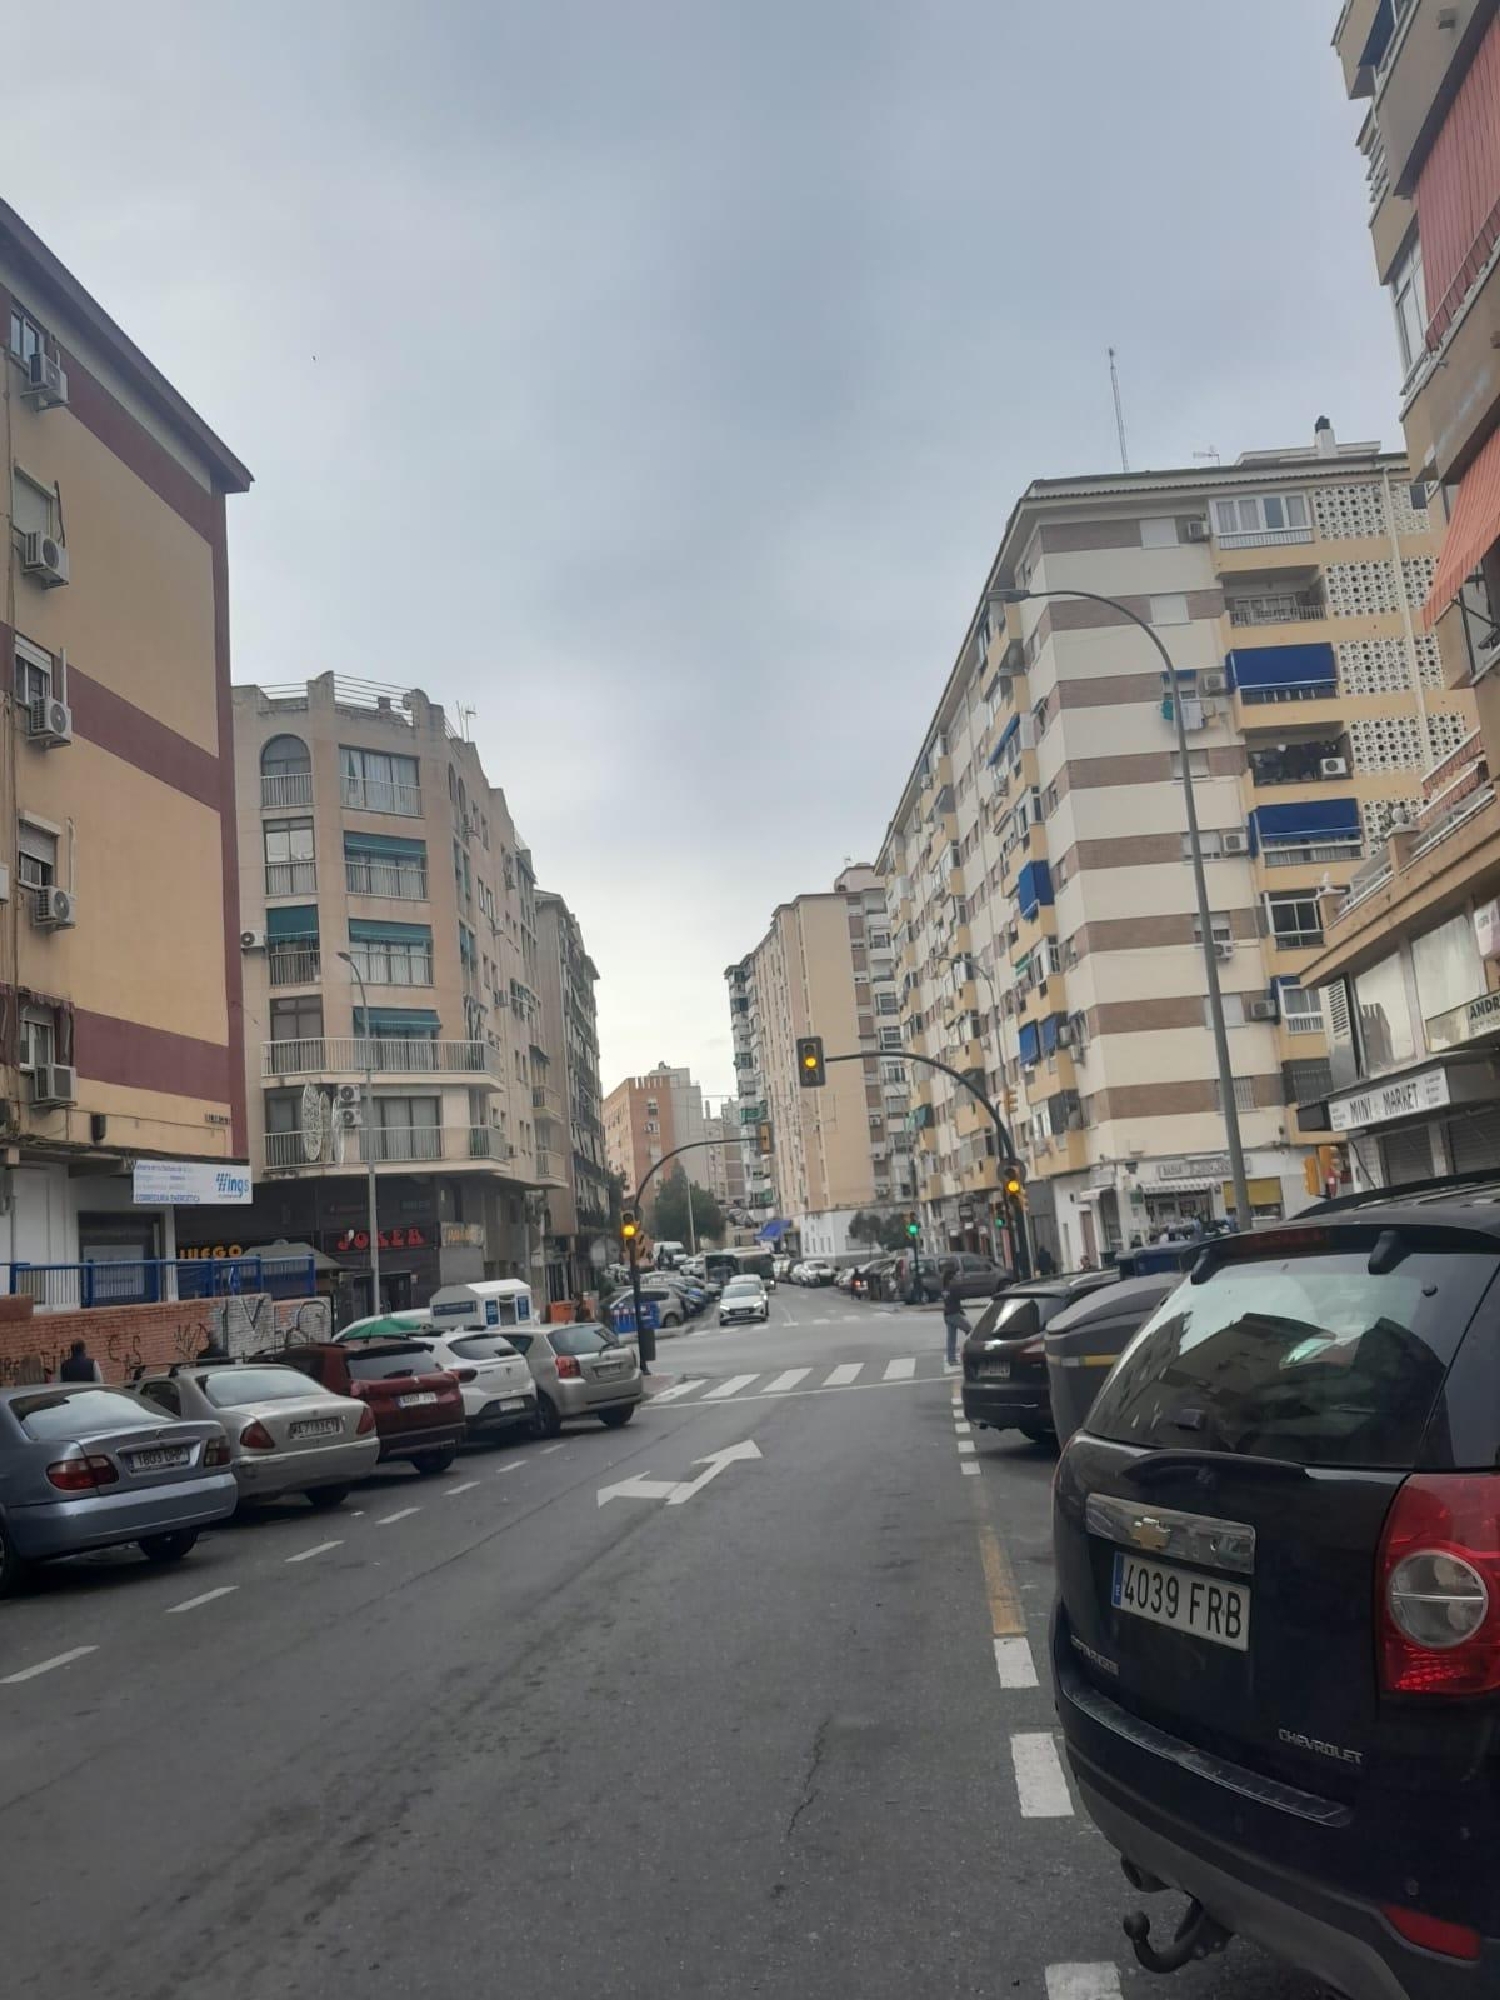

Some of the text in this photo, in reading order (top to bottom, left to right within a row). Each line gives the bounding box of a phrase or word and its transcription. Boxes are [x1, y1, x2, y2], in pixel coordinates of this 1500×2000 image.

[1469, 994, 1500, 1020] ANDR
[1383, 1082, 1420, 1116] MARKET
[1124, 1564, 1241, 1639] 4039 FRB
[1279, 1728, 1363, 1764] CHEVROLET
